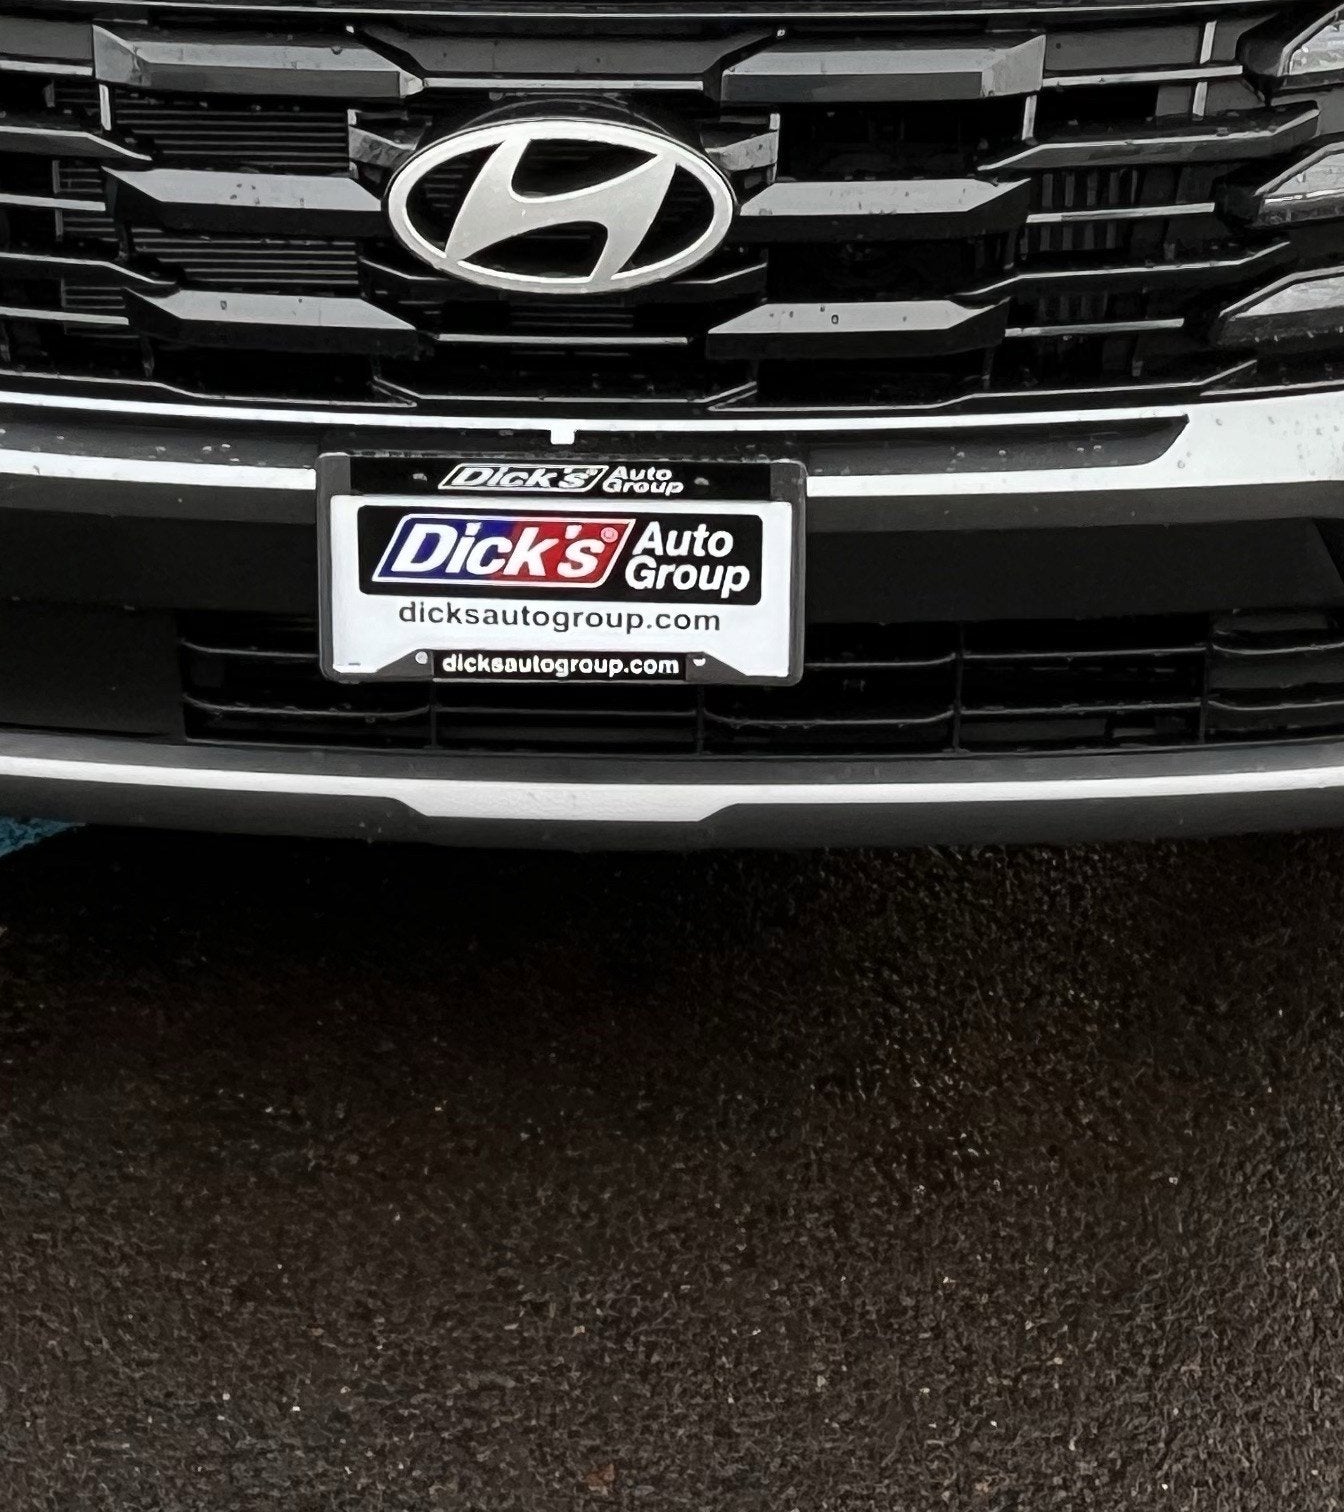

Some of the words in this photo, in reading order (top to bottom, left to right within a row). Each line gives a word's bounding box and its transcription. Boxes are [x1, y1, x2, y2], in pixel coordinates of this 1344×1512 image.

[451, 466, 589, 489] Dick's
[607, 465, 673, 481] Auto
[602, 478, 684, 497] Group
[391, 521, 602, 578] Dick's
[632, 521, 734, 558] Auto
[624, 554, 750, 599] Group
[398, 600, 721, 635] dicksautogroup.com
[442, 653, 680, 678] dicksautogroup.com
